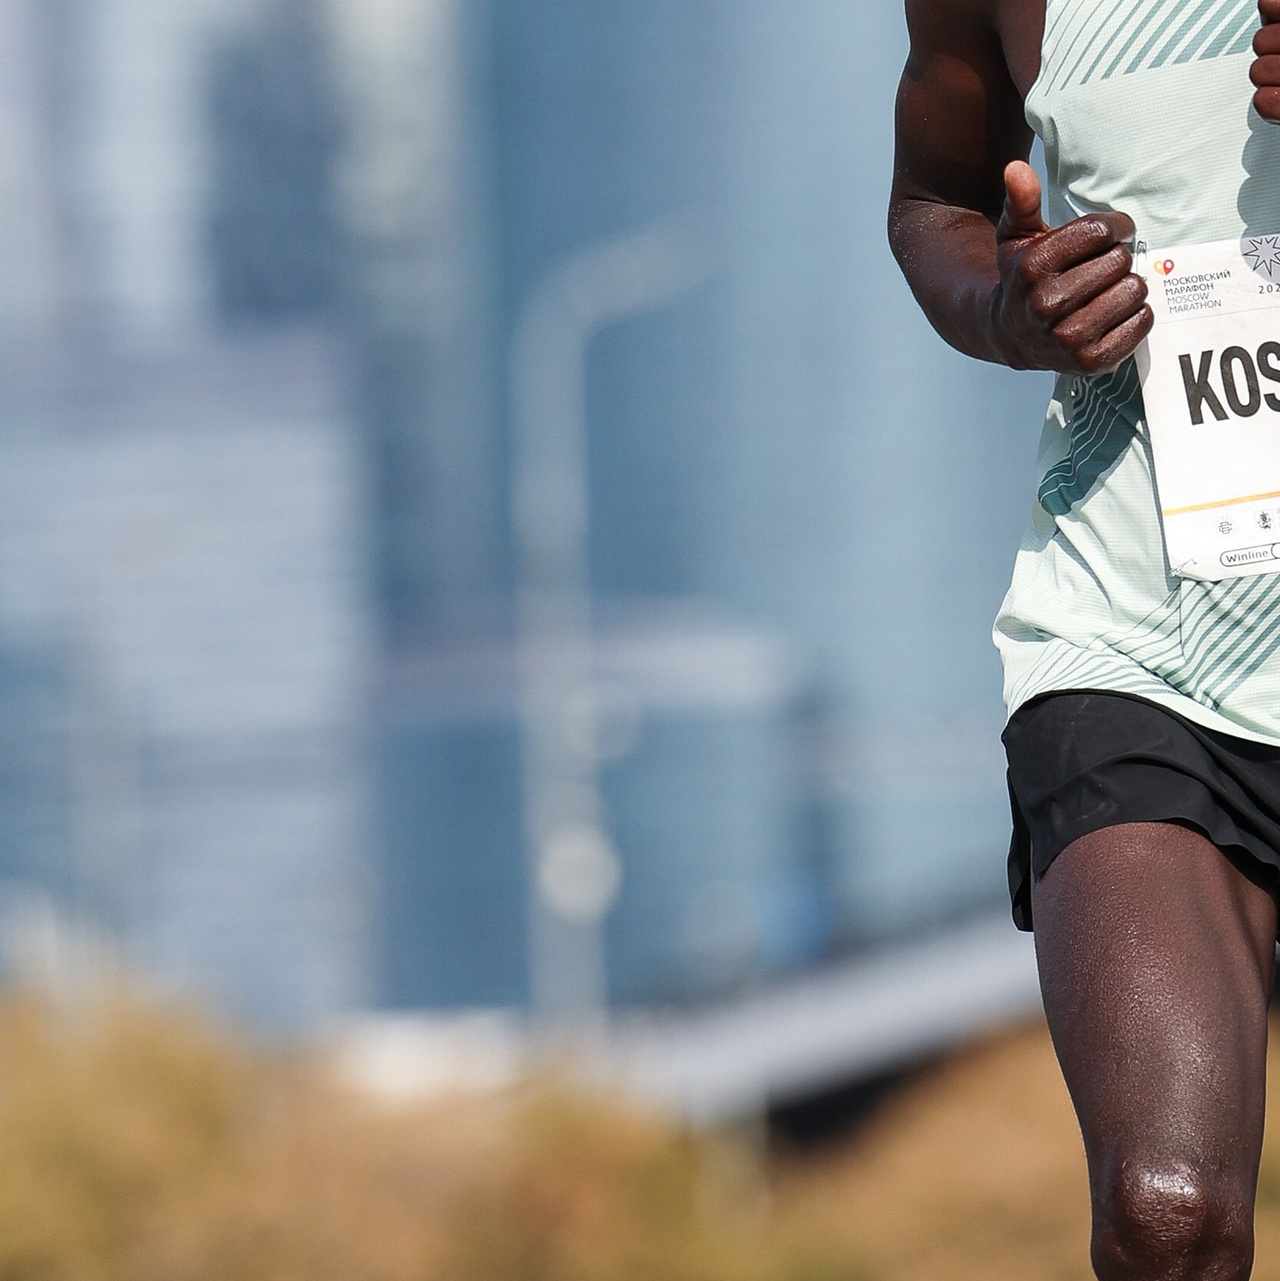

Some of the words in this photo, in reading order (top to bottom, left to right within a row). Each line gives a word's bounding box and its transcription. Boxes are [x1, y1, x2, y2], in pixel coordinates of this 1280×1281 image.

[1163, 269, 1232, 288] МОСКОВСКИЙ
[1165, 282, 1215, 297] МАРАФОН
[1167, 292, 1210, 306] MOSCOW
[1169, 299, 1222, 314] MARATHON
[1225, 548, 1269, 563] Winline
